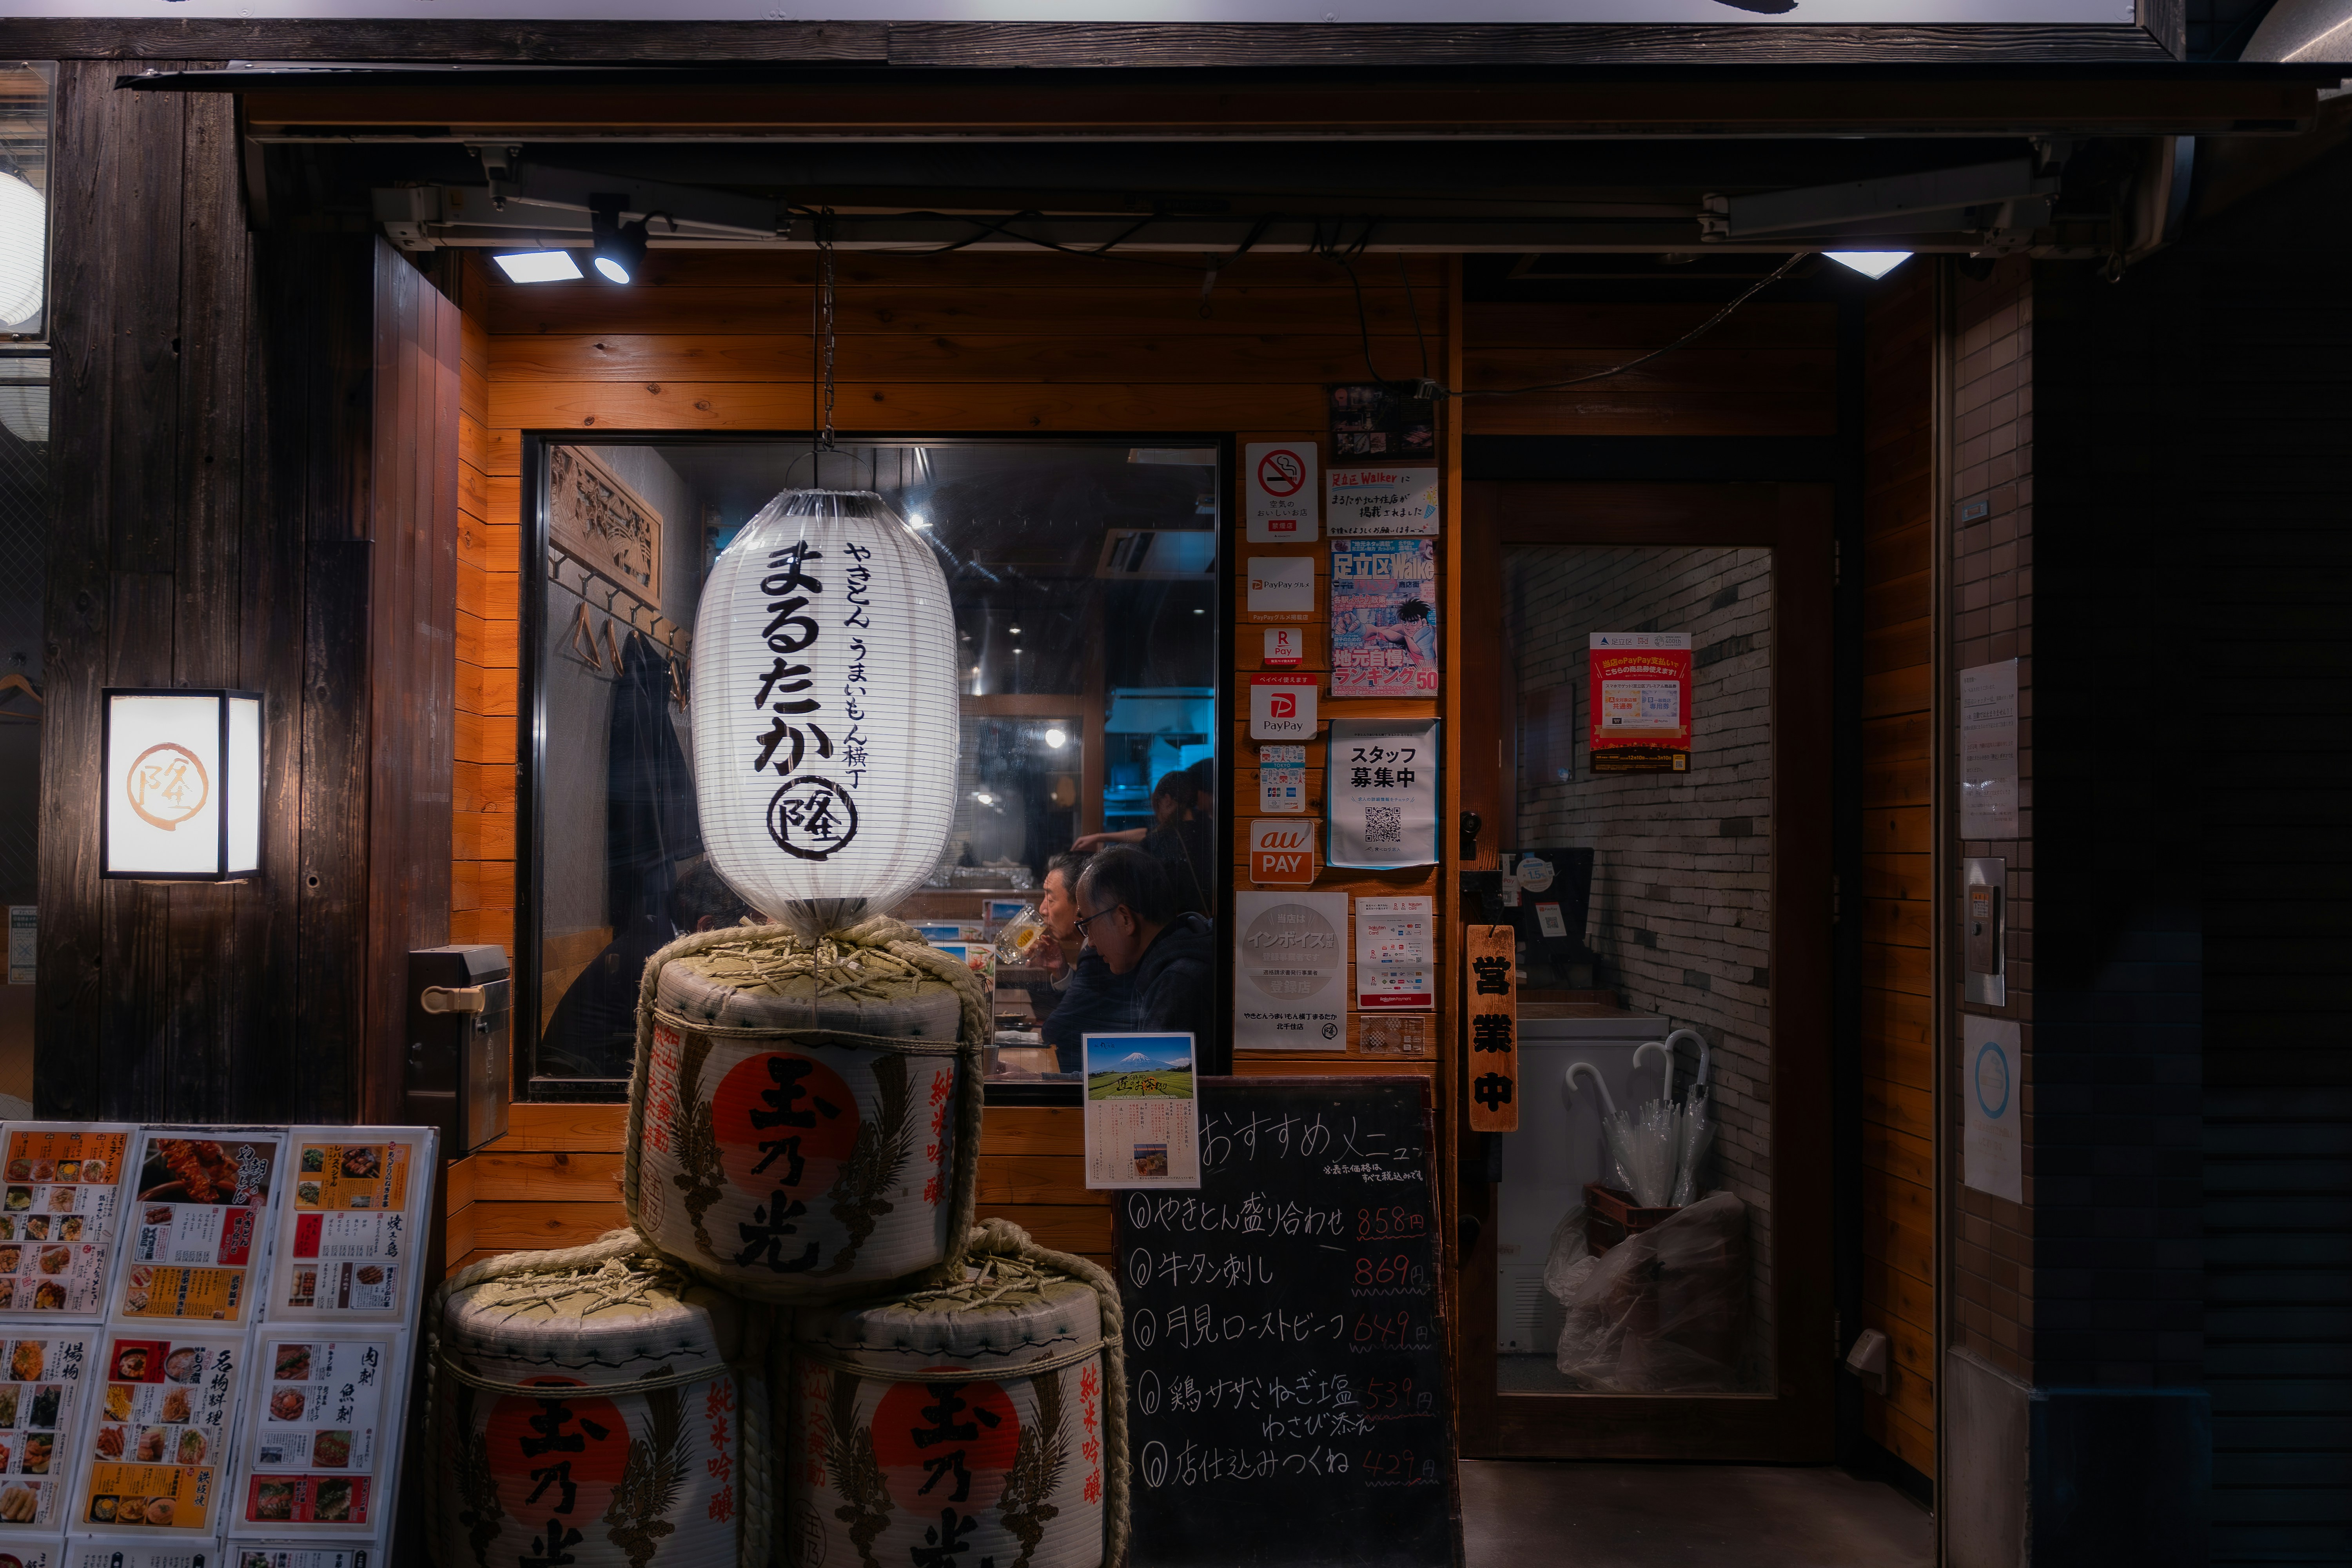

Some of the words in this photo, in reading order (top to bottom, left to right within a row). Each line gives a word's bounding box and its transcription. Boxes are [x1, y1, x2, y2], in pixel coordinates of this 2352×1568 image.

[1332, 474, 1359, 486] 足立区
[1361, 472, 1397, 484] Walker
[1332, 494, 1410, 506] まるたか北千住店が
[1359, 506, 1422, 518] 掲載されました
[844, 542, 871, 628] やきとん
[755, 539, 833, 776] まるたか
[1334, 649, 1403, 667] 地元自慢
[1602, 656, 1679, 669] 当店のPayPay支払いで
[1605, 666, 1677, 676] こちらの商品券使えます!
[1334, 667, 1415, 686] ランキング
[1416, 671, 1438, 690] 50
[842, 637, 869, 789] うまいもん横丁
[1264, 721, 1303, 732] PayPay
[1351, 746, 1416, 764] スタッフ
[1351, 767, 1415, 788] 募集中
[1261, 832, 1305, 849] au
[1263, 855, 1302, 872] PAY
[1278, 914, 1305, 924] 当店は
[1247, 931, 1326, 949] インボイス
[1262, 953, 1319, 962] 登録事業者です
[1270, 981, 1310, 994] 登録店
[1472, 956, 1513, 1112] 営業中
[232, 1144, 256, 1204] やきとん
[330, 1145, 341, 1187] レバスペシャル
[733, 1057, 842, 1273] 玉乃光
[239, 1211, 253, 1247] やきとん
[1155, 1192, 1345, 1237] やきとん盛り合わせ
[1357, 1205, 1425, 1236] 858円
[385, 1214, 403, 1257] 焼き鳥
[1158, 1251, 1273, 1288] 牛タン刺し
[1354, 1254, 1424, 1285] 869円
[1166, 1304, 1343, 1349] 月見ローストビーフ
[1354, 1311, 1428, 1345] 649円
[62, 1342, 83, 1379] 揚物
[189, 1353, 203, 1385] もつ煮
[358, 1347, 378, 1386] 肉刺
[205, 1350, 233, 1426] 名物料理
[313, 1386, 323, 1420] ローストビーフ
[336, 1383, 354, 1424] 魚刺
[1367, 1377, 1432, 1410] 539円
[1263, 1413, 1375, 1441] わさび添え
[910, 1381, 1001, 1568] 玉乃光
[1171, 1440, 1348, 1486] 店仕込みつくね
[1362, 1449, 1434, 1480] 429円
[194, 1471, 211, 1506] 鉄板焼
